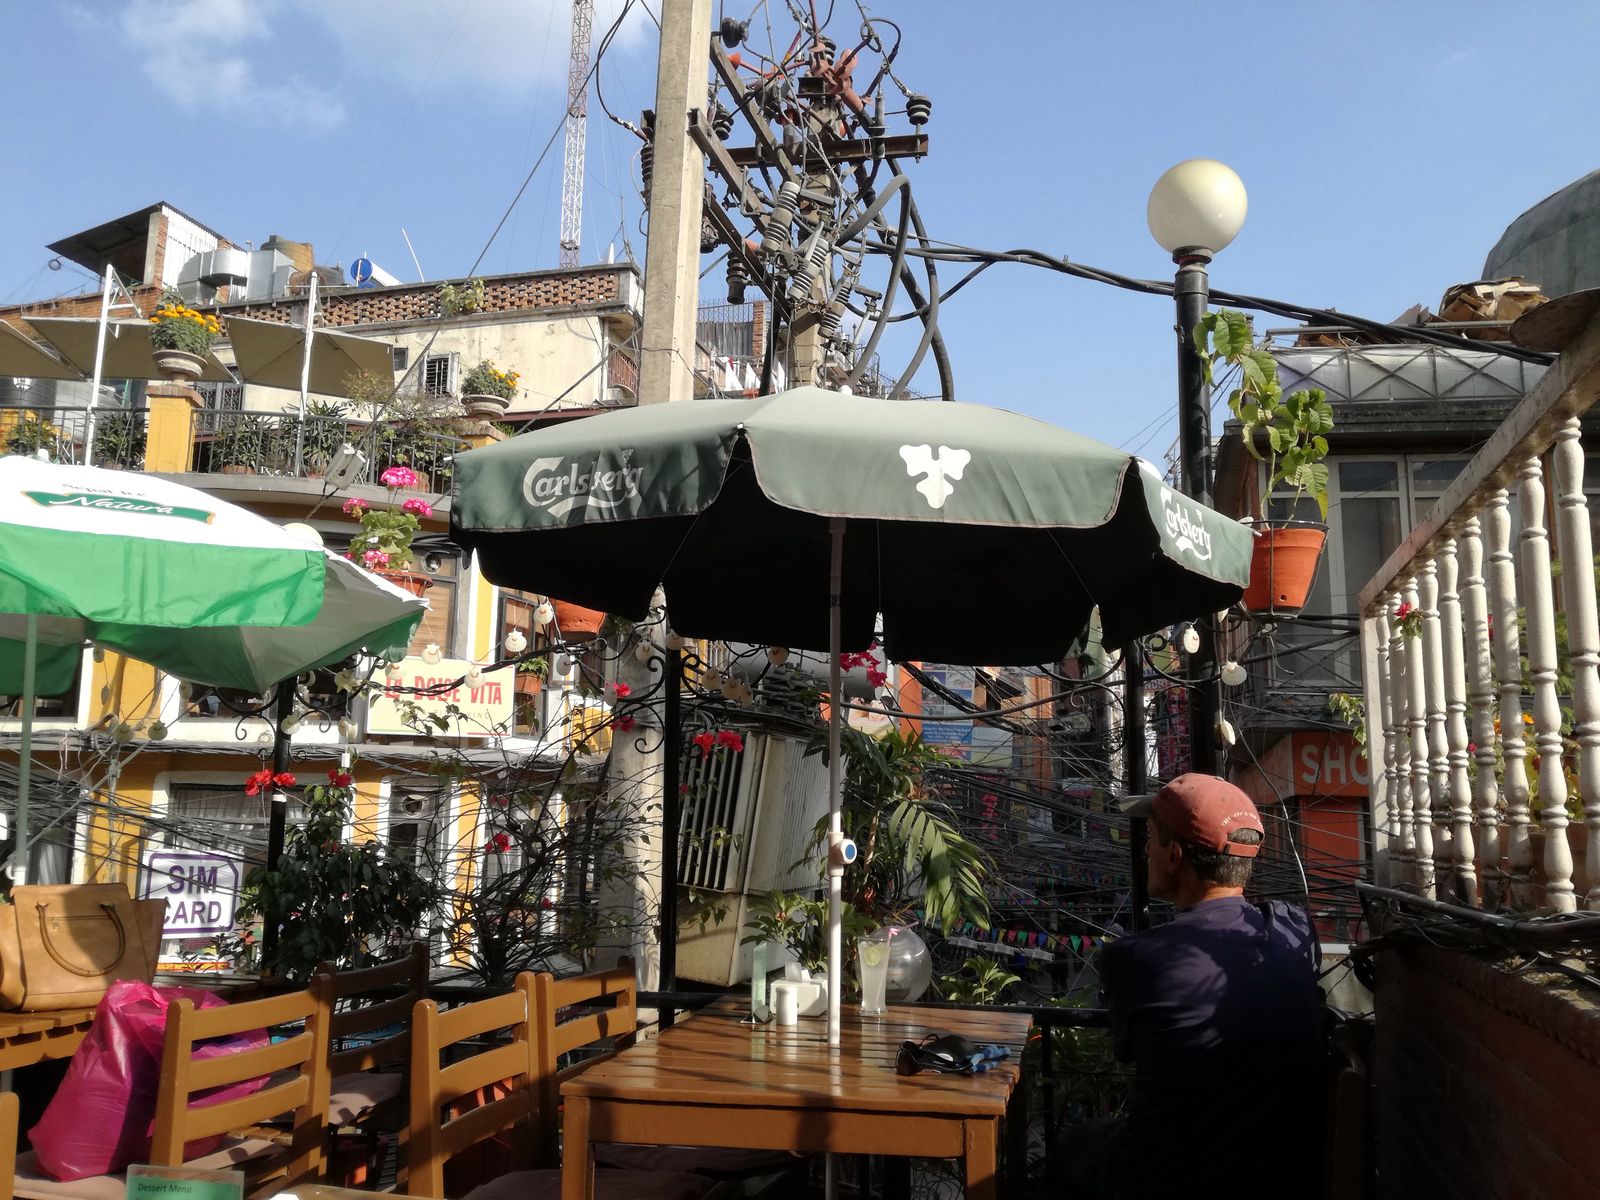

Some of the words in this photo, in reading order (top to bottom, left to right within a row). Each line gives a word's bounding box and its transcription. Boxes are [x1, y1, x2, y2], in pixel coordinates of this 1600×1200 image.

[523, 455, 644, 511] Carlsberg
[50, 496, 173, 514] Natura
[470, 681, 502, 705] VITA
[167, 865, 218, 895] SIM
[137, 1183, 166, 1192] Dessert
[168, 1184, 192, 1193] Menu
